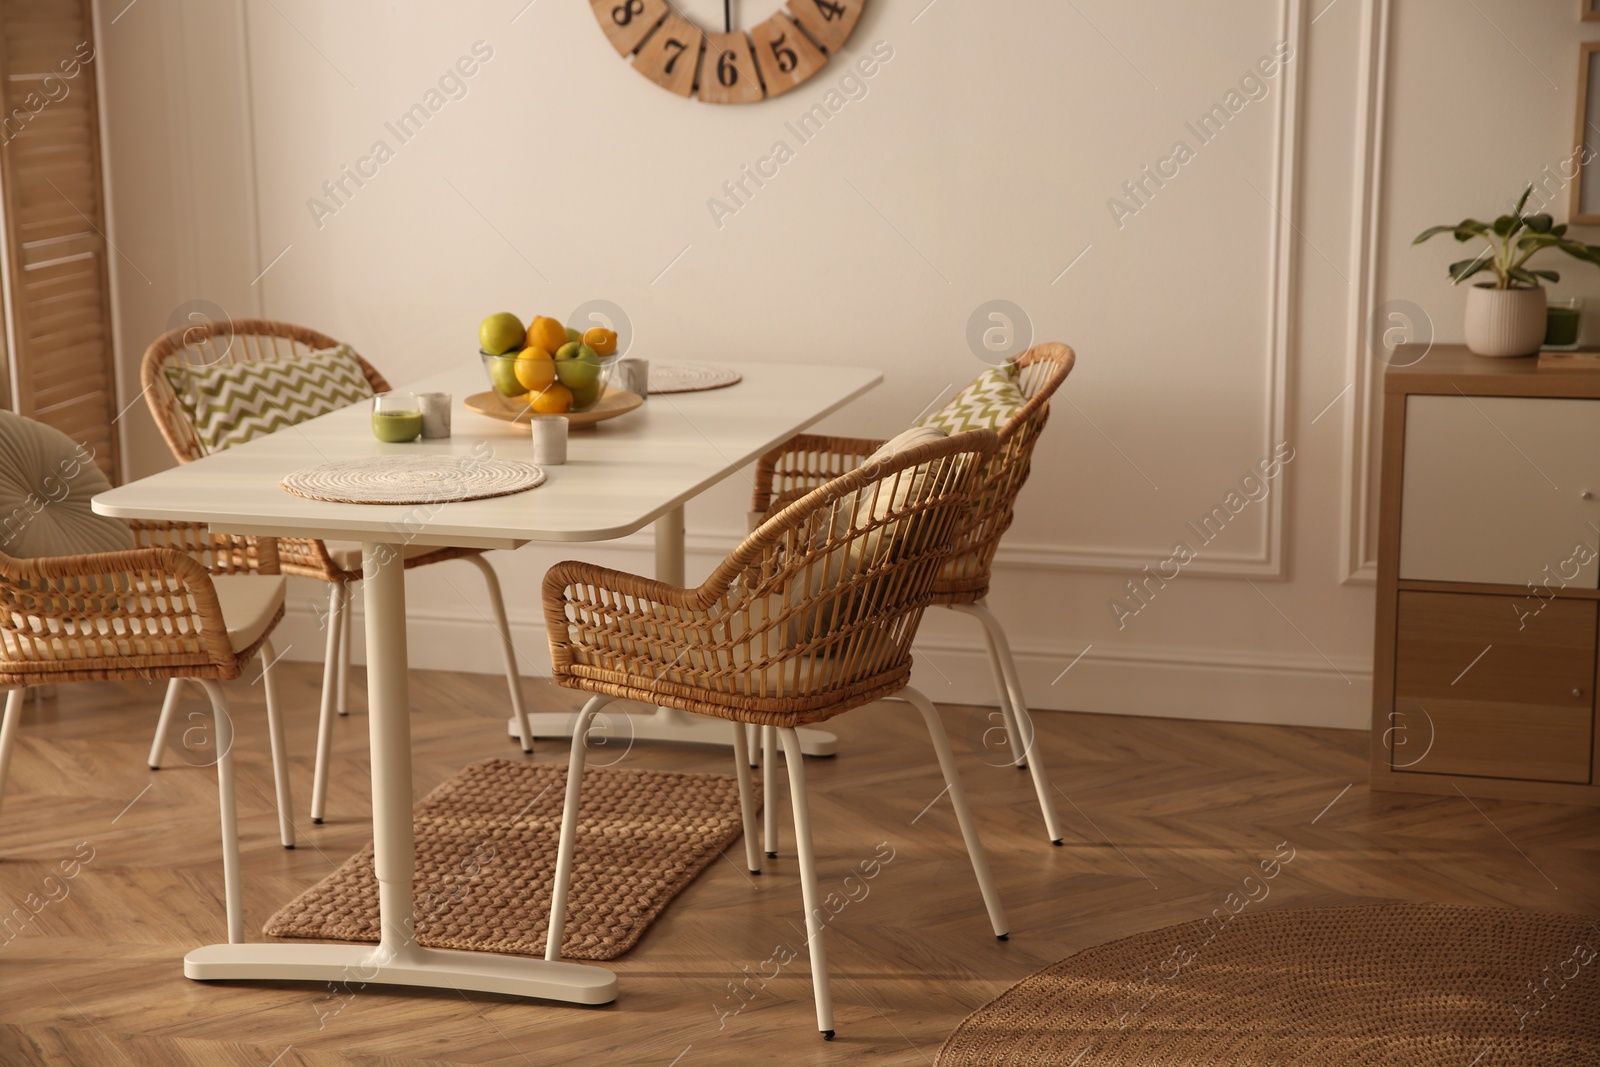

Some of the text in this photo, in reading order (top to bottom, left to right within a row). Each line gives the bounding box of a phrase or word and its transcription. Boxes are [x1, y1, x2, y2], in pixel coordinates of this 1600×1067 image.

[612, 0, 644, 27] 8
[813, 0, 846, 22] 4
[664, 37, 688, 75] 7
[717, 50, 738, 88] 6
[770, 33, 798, 73] 5
